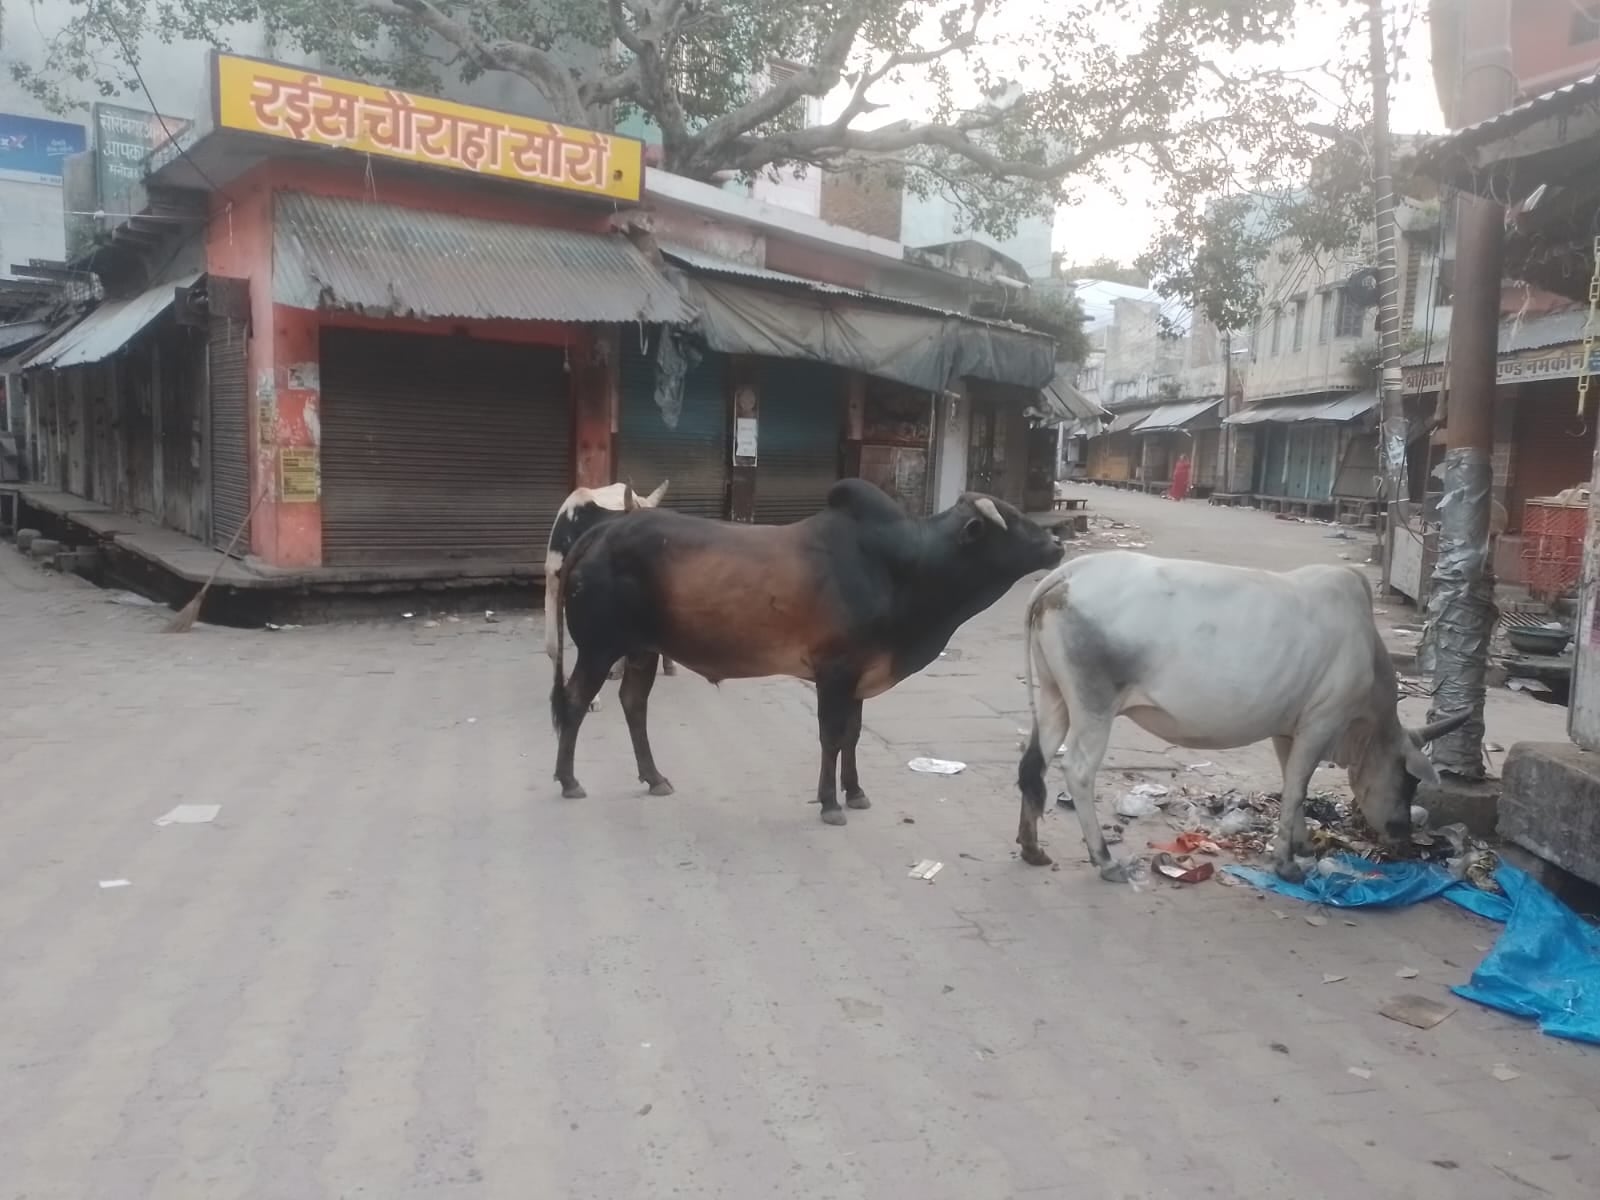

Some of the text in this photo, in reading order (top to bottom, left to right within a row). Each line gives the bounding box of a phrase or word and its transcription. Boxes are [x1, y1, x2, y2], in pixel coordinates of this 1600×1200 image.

[250, 73, 612, 189] रईस चौराहा सोरों
[1526, 352, 1584, 374] नमकीन
